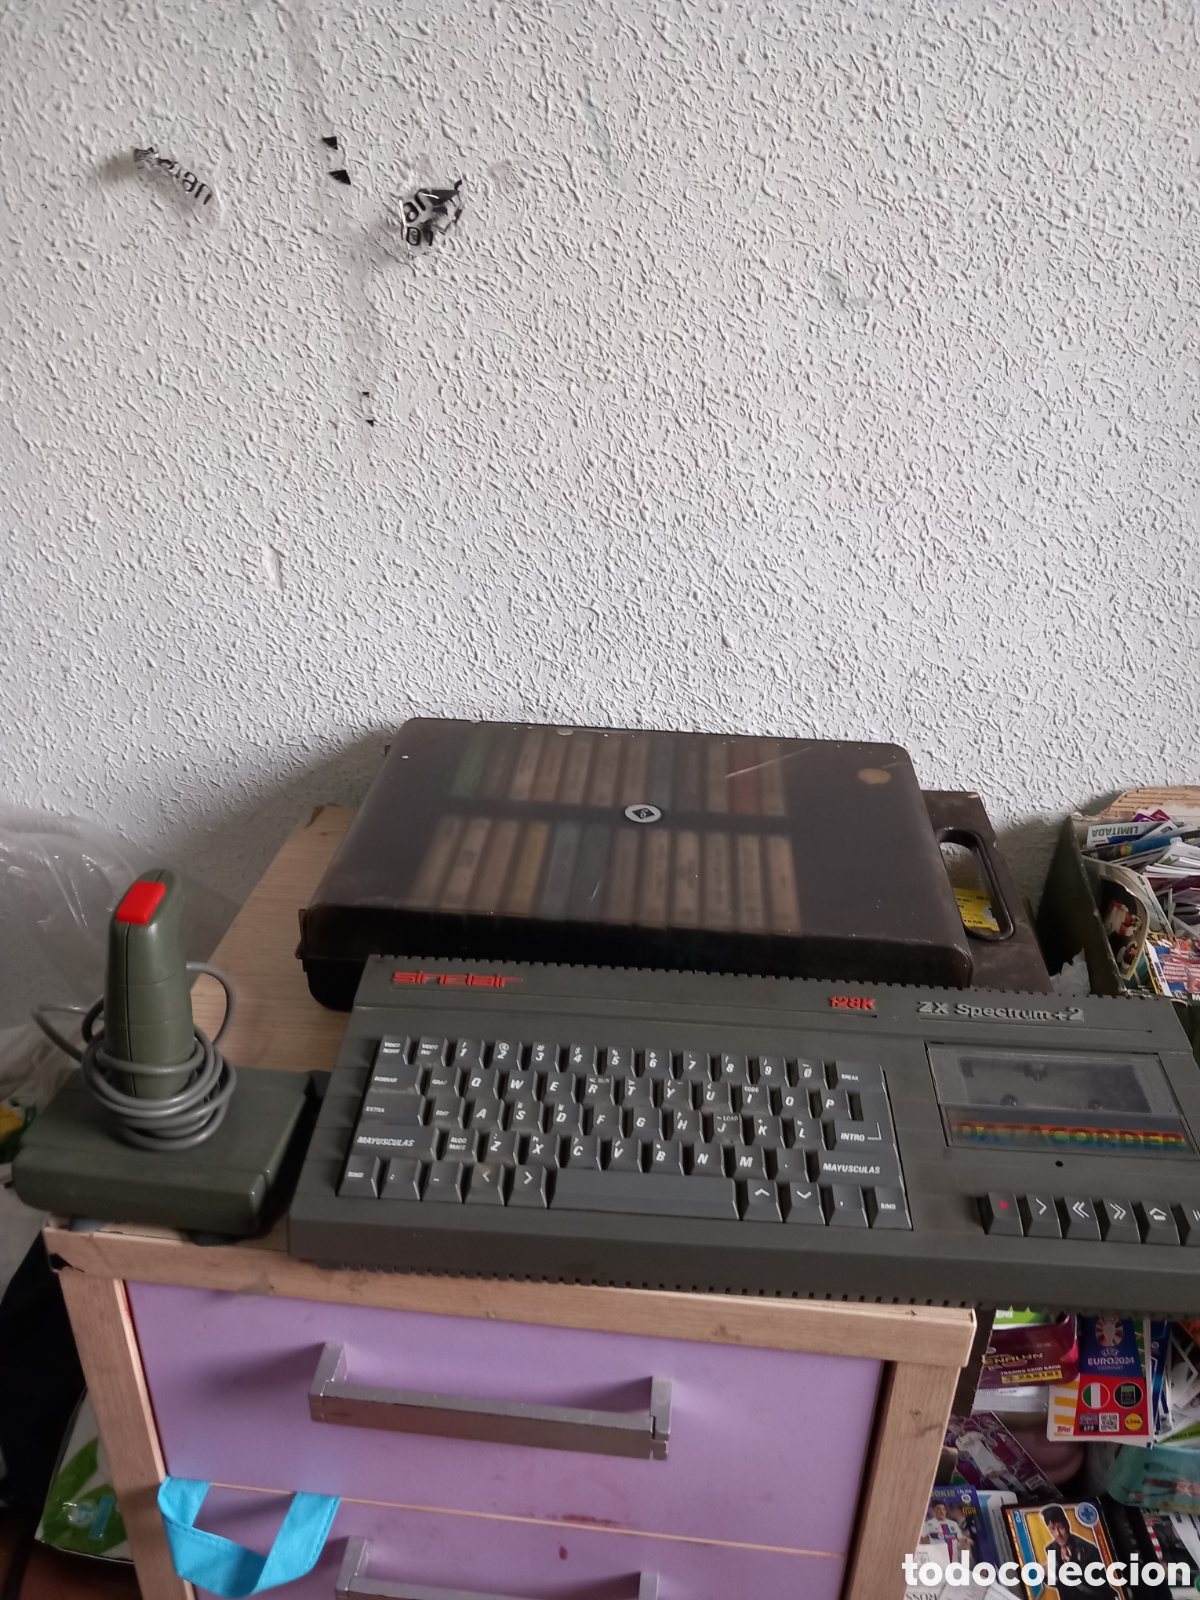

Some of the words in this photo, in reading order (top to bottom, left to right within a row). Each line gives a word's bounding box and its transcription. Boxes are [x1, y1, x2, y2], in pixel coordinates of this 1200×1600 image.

[1091, 826, 1139, 838] LIMITADA
[829, 995, 875, 1010] 128K
[917, 1001, 948, 1016] ZX
[535, 1052, 545, 1061] 3
[611, 1056, 620, 1066] 5
[648, 1058, 658, 1068] 6
[688, 1060, 697, 1070] 7
[725, 1063, 735, 1073] 8
[764, 1066, 773, 1076] 9
[471, 1077, 482, 1088] Q
[841, 1073, 859, 1082] BREAK
[510, 1079, 524, 1090] W
[549, 1081, 560, 1092] E
[588, 1084, 598, 1094] R
[627, 1086, 636, 1096] T
[666, 1088, 676, 1098] Y
[706, 1091, 716, 1101] U
[365, 1105, 385, 1114] EXTRA
[825, 1099, 835, 1109] P
[475, 1108, 488, 1119] A
[515, 1110, 526, 1121] S
[556, 1112, 567, 1123] D
[596, 1114, 606, 1125] F
[636, 1117, 646, 1128] G
[677, 1119, 688, 1131] H
[757, 1125, 768, 1136] K
[356, 1136, 415, 1147] MAYUSCULAS
[840, 1132, 866, 1142] INTRO
[490, 1140, 502, 1152] Z
[532, 1143, 544, 1155] X
[573, 1145, 584, 1156] C
[614, 1147, 624, 1159] V
[656, 1150, 666, 1162] B
[697, 1153, 709, 1165] N
[740, 1156, 754, 1168] M
[822, 1162, 881, 1175] MAYUSCULAS
[1087, 1356, 1135, 1366] EURO2024
